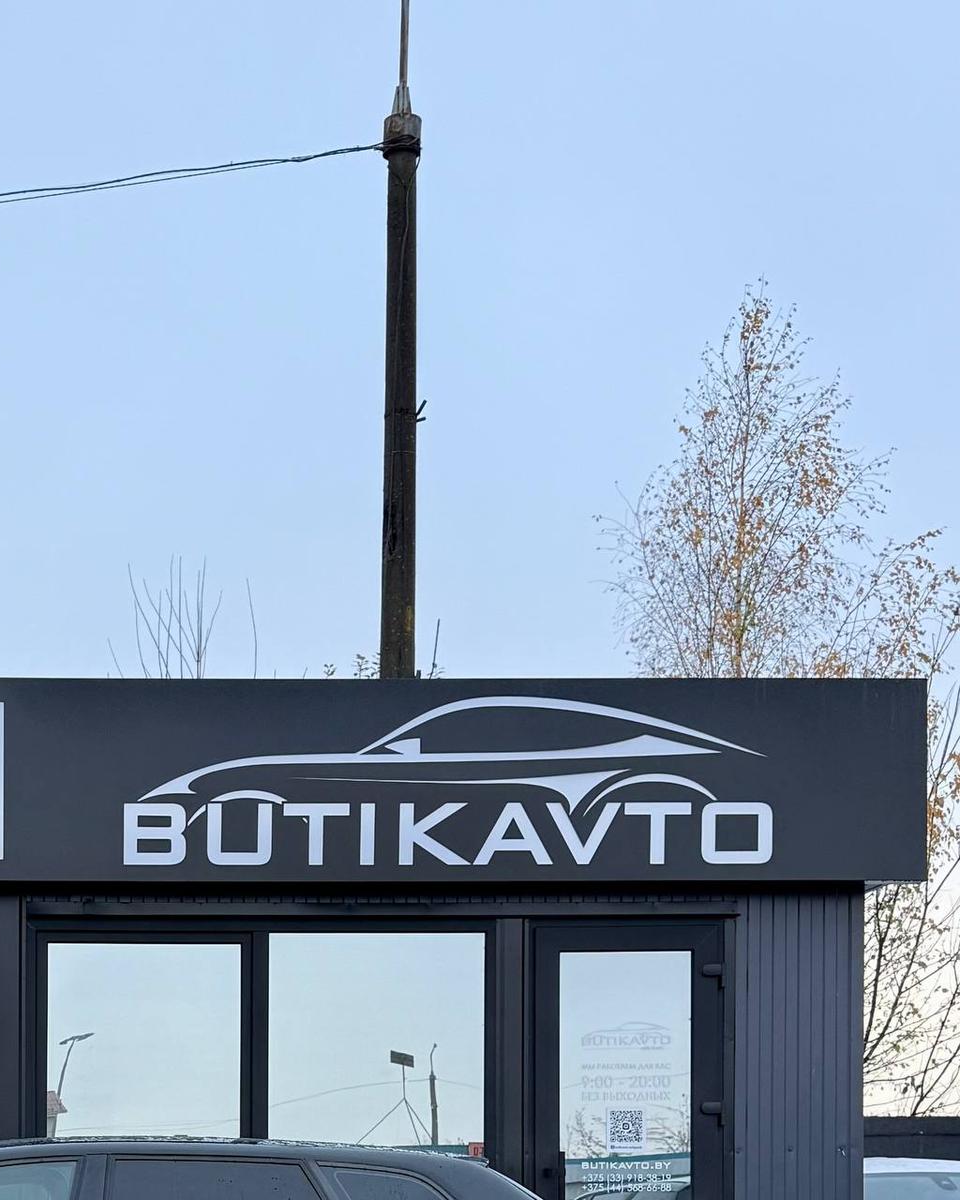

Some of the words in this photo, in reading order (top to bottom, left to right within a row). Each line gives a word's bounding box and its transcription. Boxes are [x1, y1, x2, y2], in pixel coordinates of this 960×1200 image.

[123, 802, 773, 866] BUTIKAVTO
[582, 1075, 613, 1089] 9:00
[628, 1075, 671, 1088] 20:00
[581, 1161, 671, 1169] BUTIKAVTO.BY
[582, 1173, 604, 1182] +375
[607, 1173, 624, 1184] (33)
[626, 1173, 672, 1182] 918-38-19
[582, 1183, 604, 1192] +375
[607, 1183, 624, 1193] (44)
[626, 1183, 672, 1192] 568-66-88
